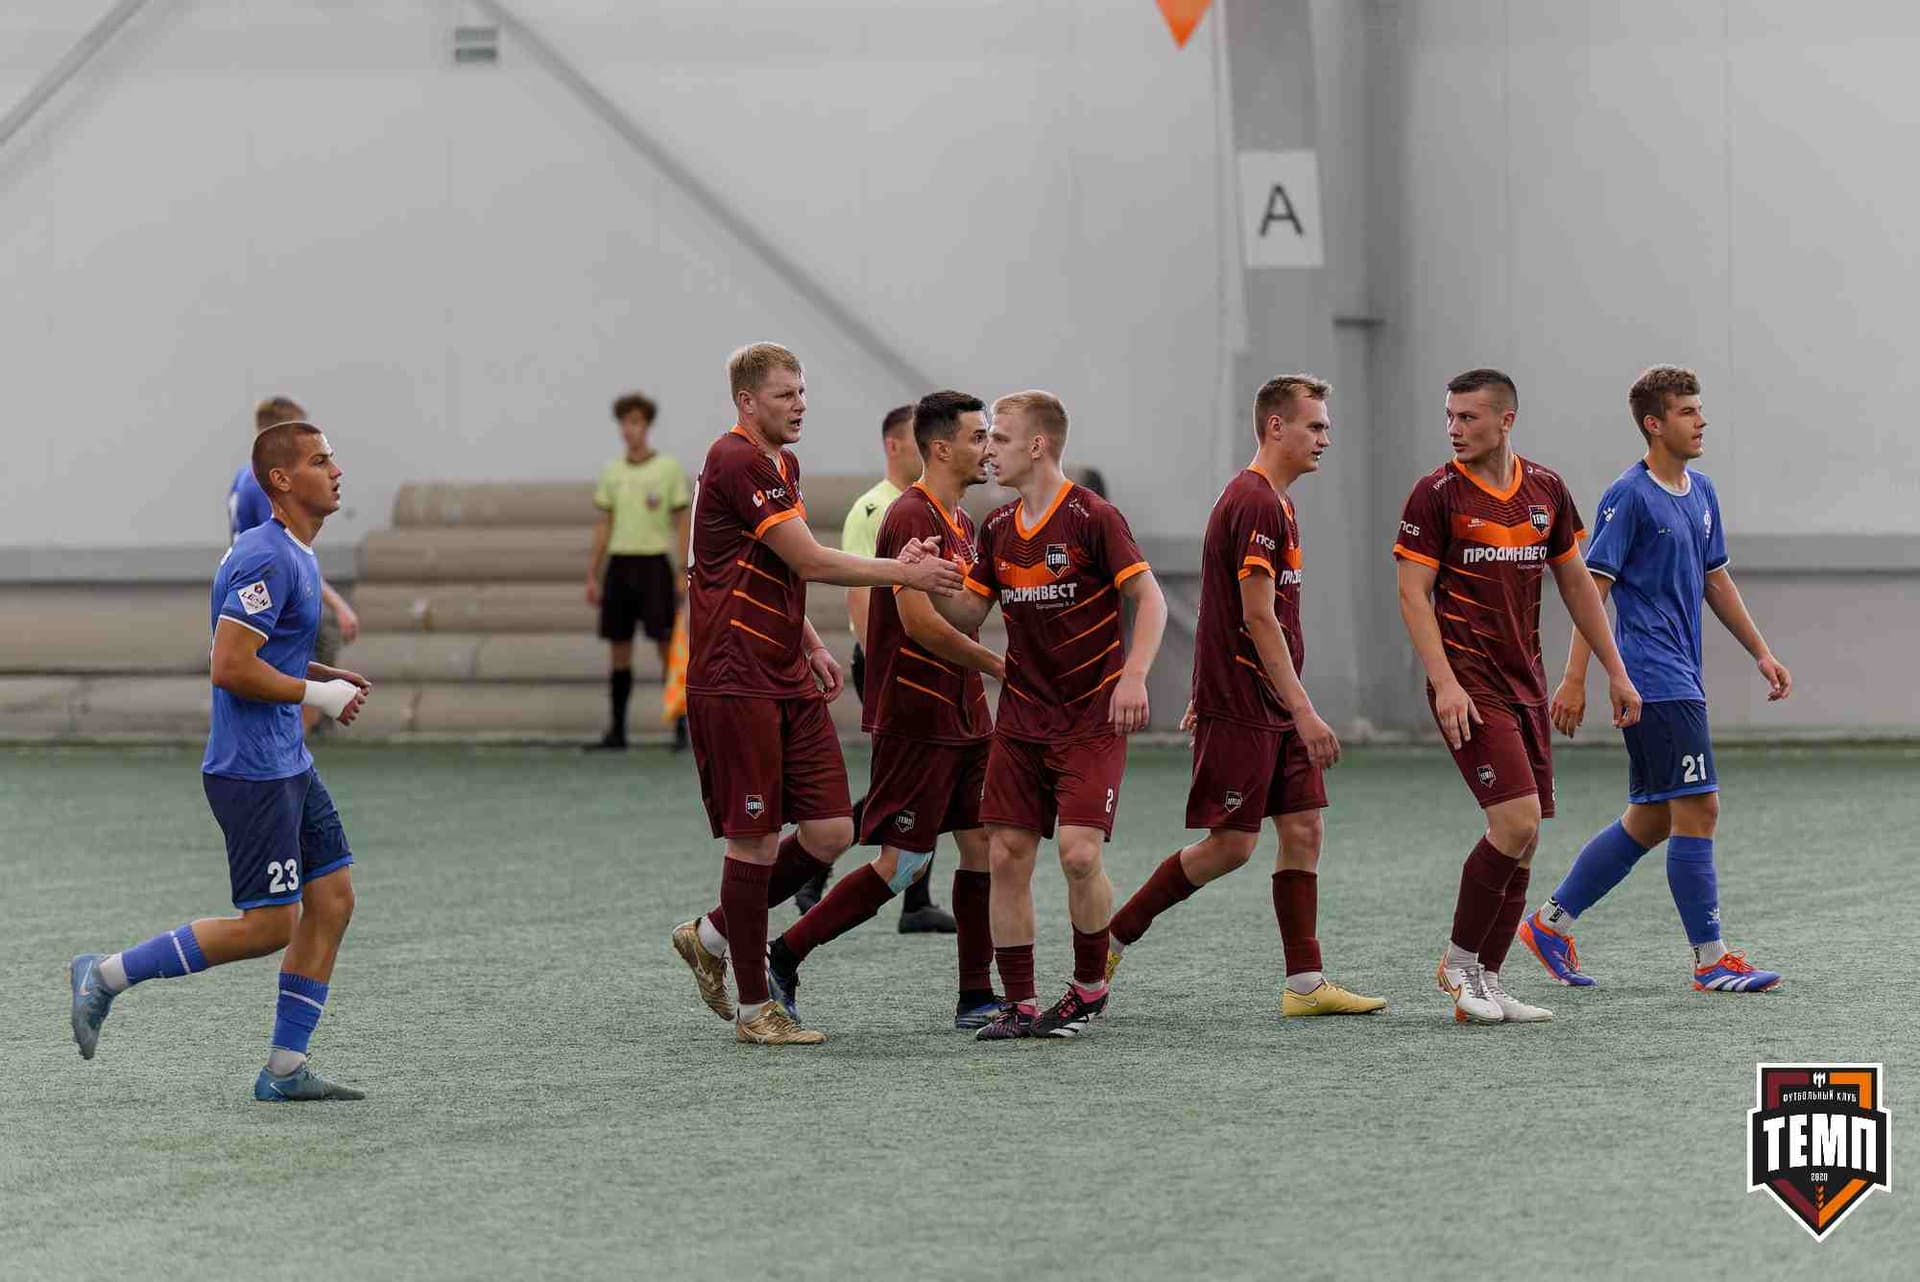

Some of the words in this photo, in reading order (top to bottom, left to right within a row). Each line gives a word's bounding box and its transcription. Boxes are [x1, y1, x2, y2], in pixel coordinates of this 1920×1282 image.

[1047, 553, 1066, 566] ТЕМП
[1463, 545, 1548, 565] ПРОДИНВЕС
[1682, 753, 1707, 784] 21
[1105, 788, 1114, 813] 2
[267, 858, 299, 894] 23
